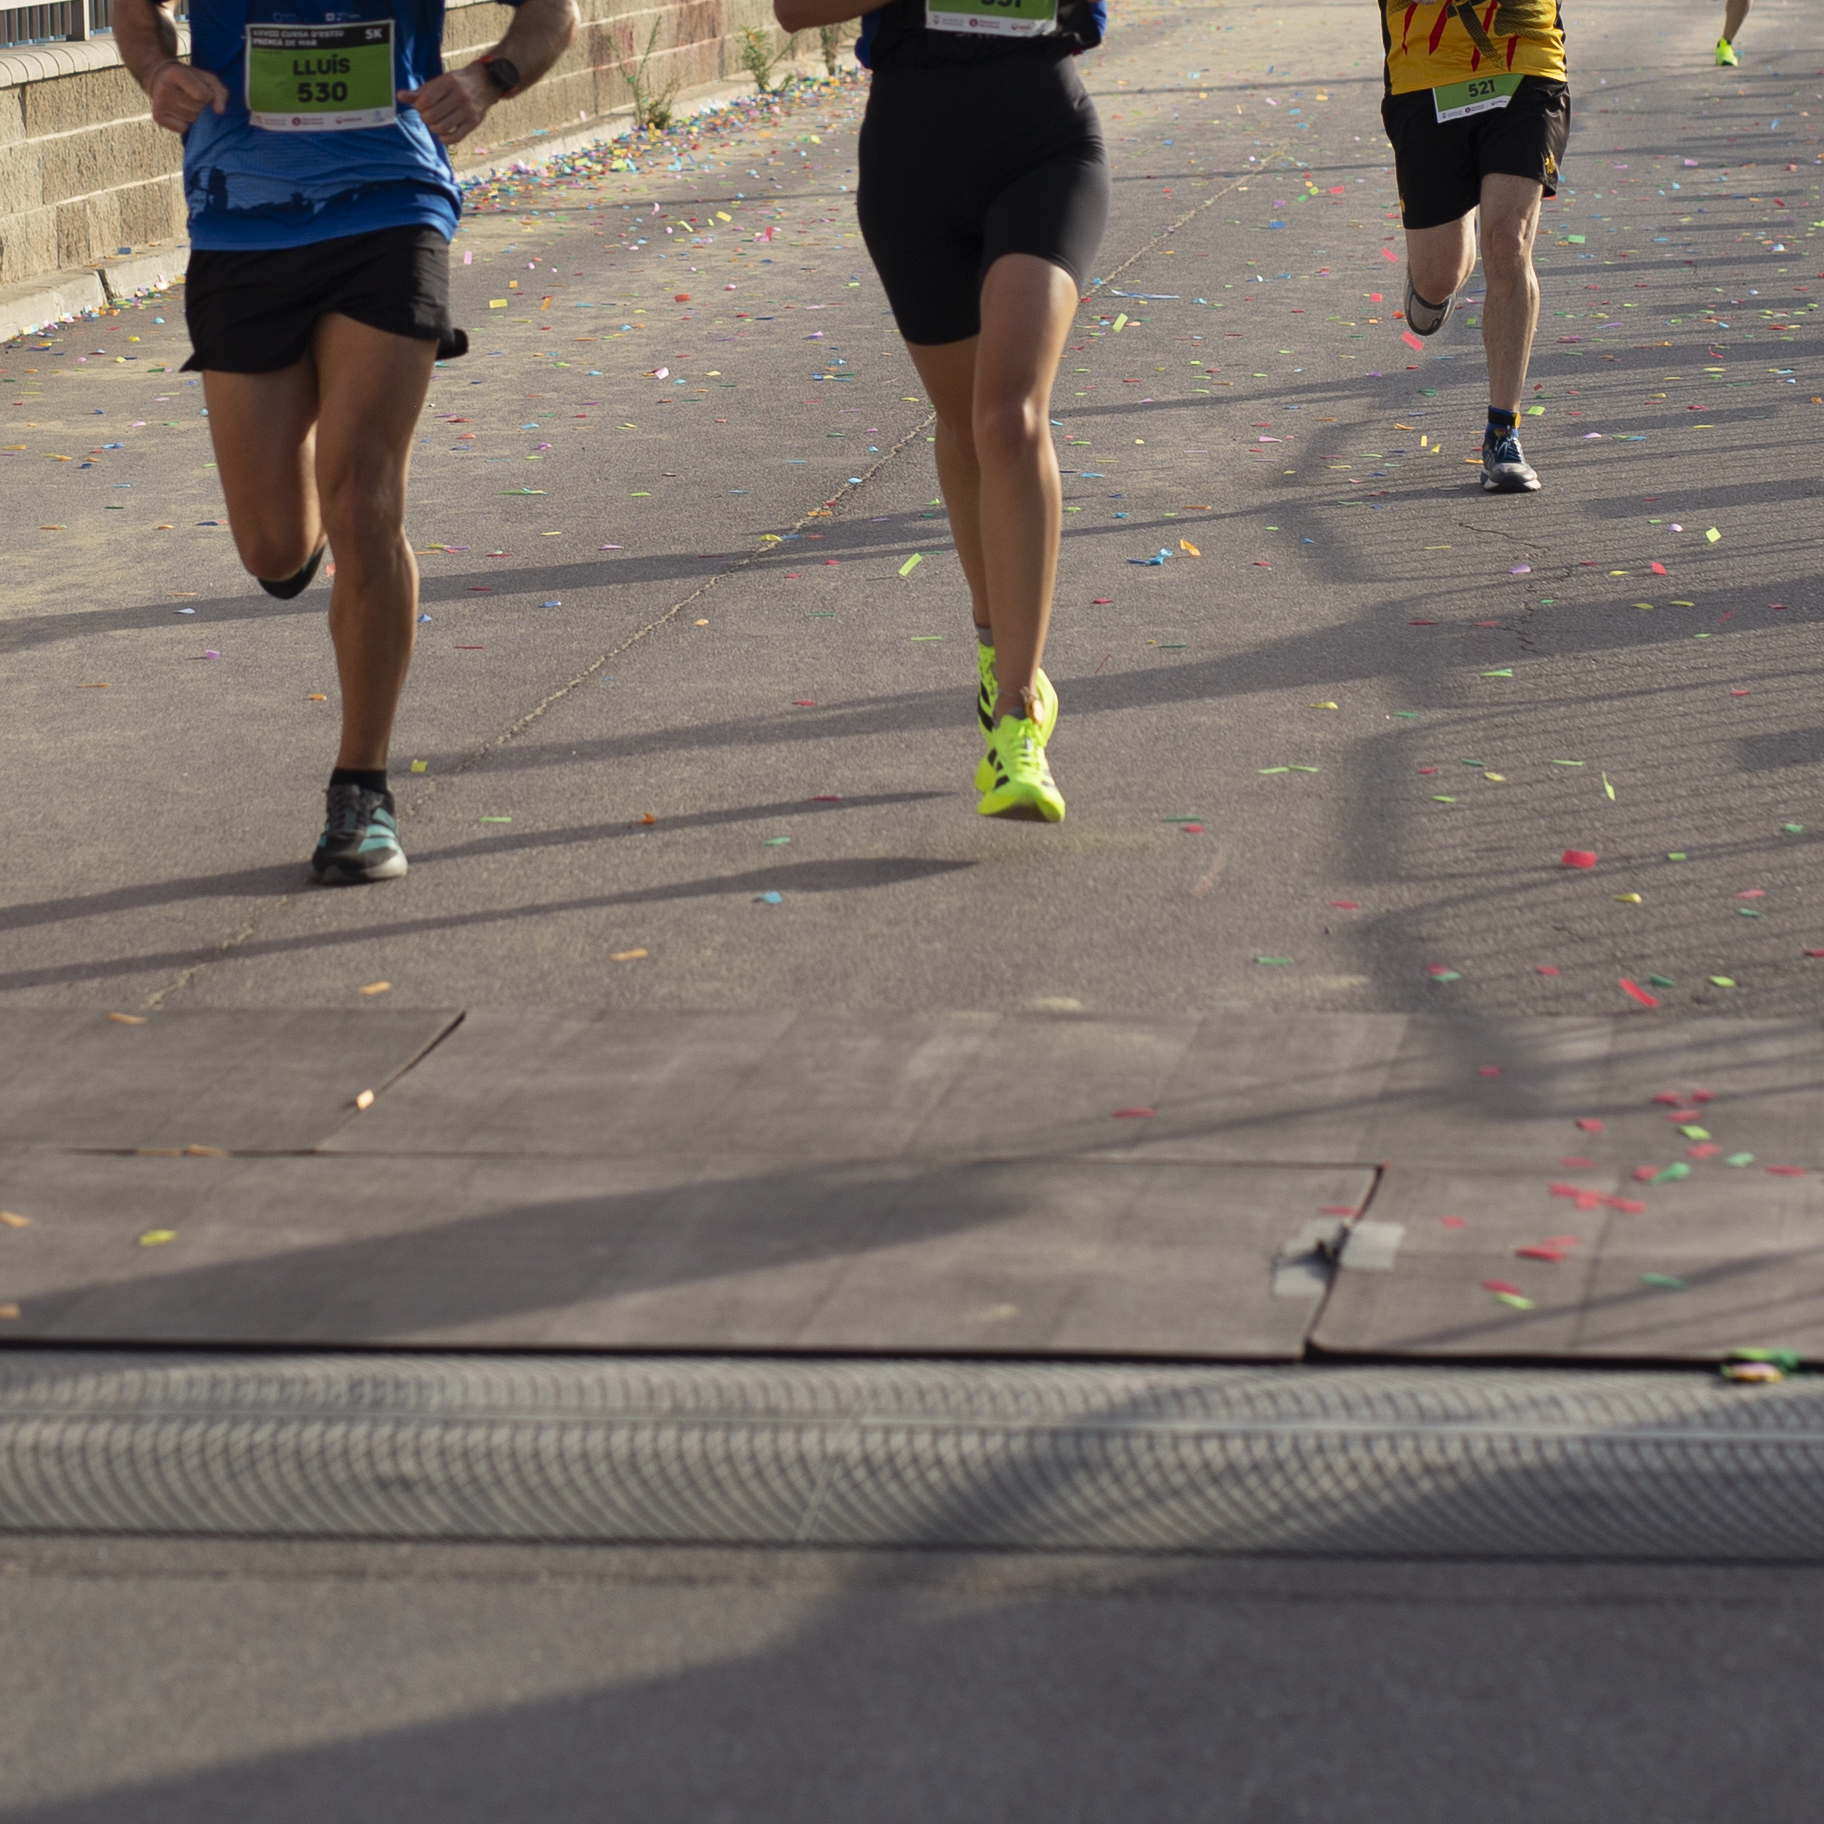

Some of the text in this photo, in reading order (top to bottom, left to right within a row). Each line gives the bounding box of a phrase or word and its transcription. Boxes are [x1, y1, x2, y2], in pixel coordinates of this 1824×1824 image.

[292, 53, 351, 76] LLUÍS
[297, 81, 348, 104] 530
[1468, 78, 1496, 98] 521
